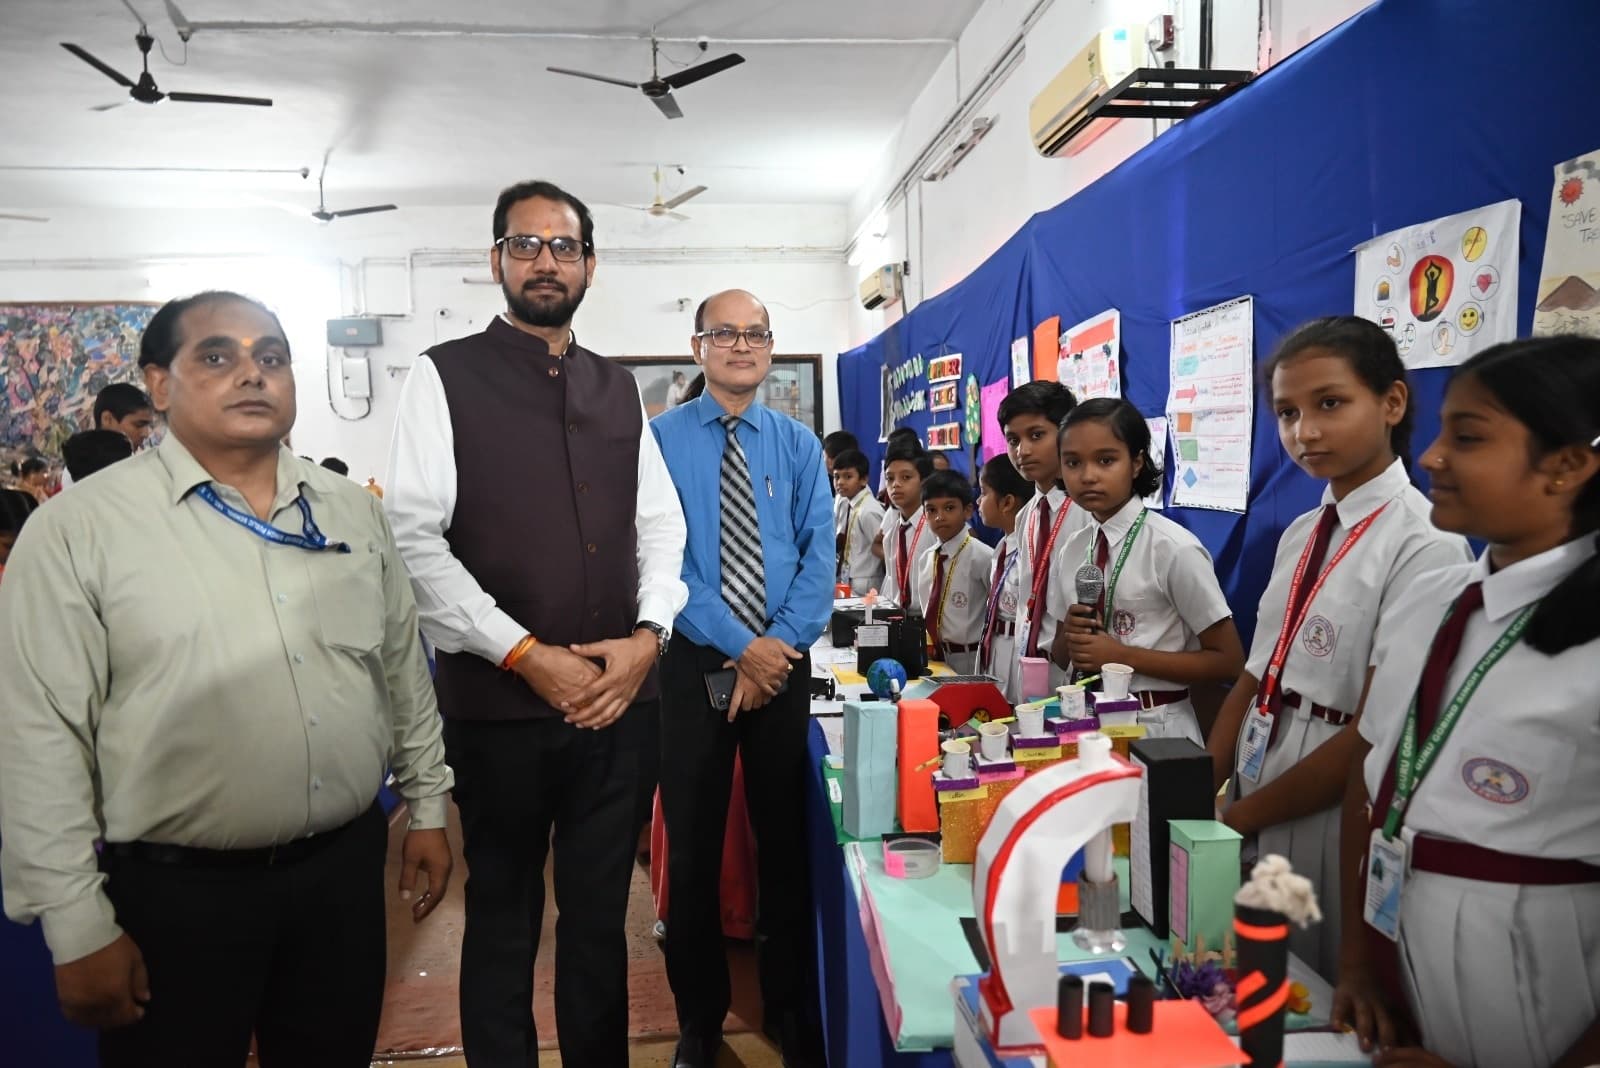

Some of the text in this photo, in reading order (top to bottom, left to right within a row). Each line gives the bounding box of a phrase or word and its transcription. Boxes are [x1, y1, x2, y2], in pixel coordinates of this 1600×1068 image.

[1413, 742, 1434, 770] GURU
[1431, 703, 1459, 742] GOBIND
[1456, 670, 1479, 703] SINGH
[1477, 636, 1509, 673] PUBLIC
[1399, 759, 1410, 789] GURU
